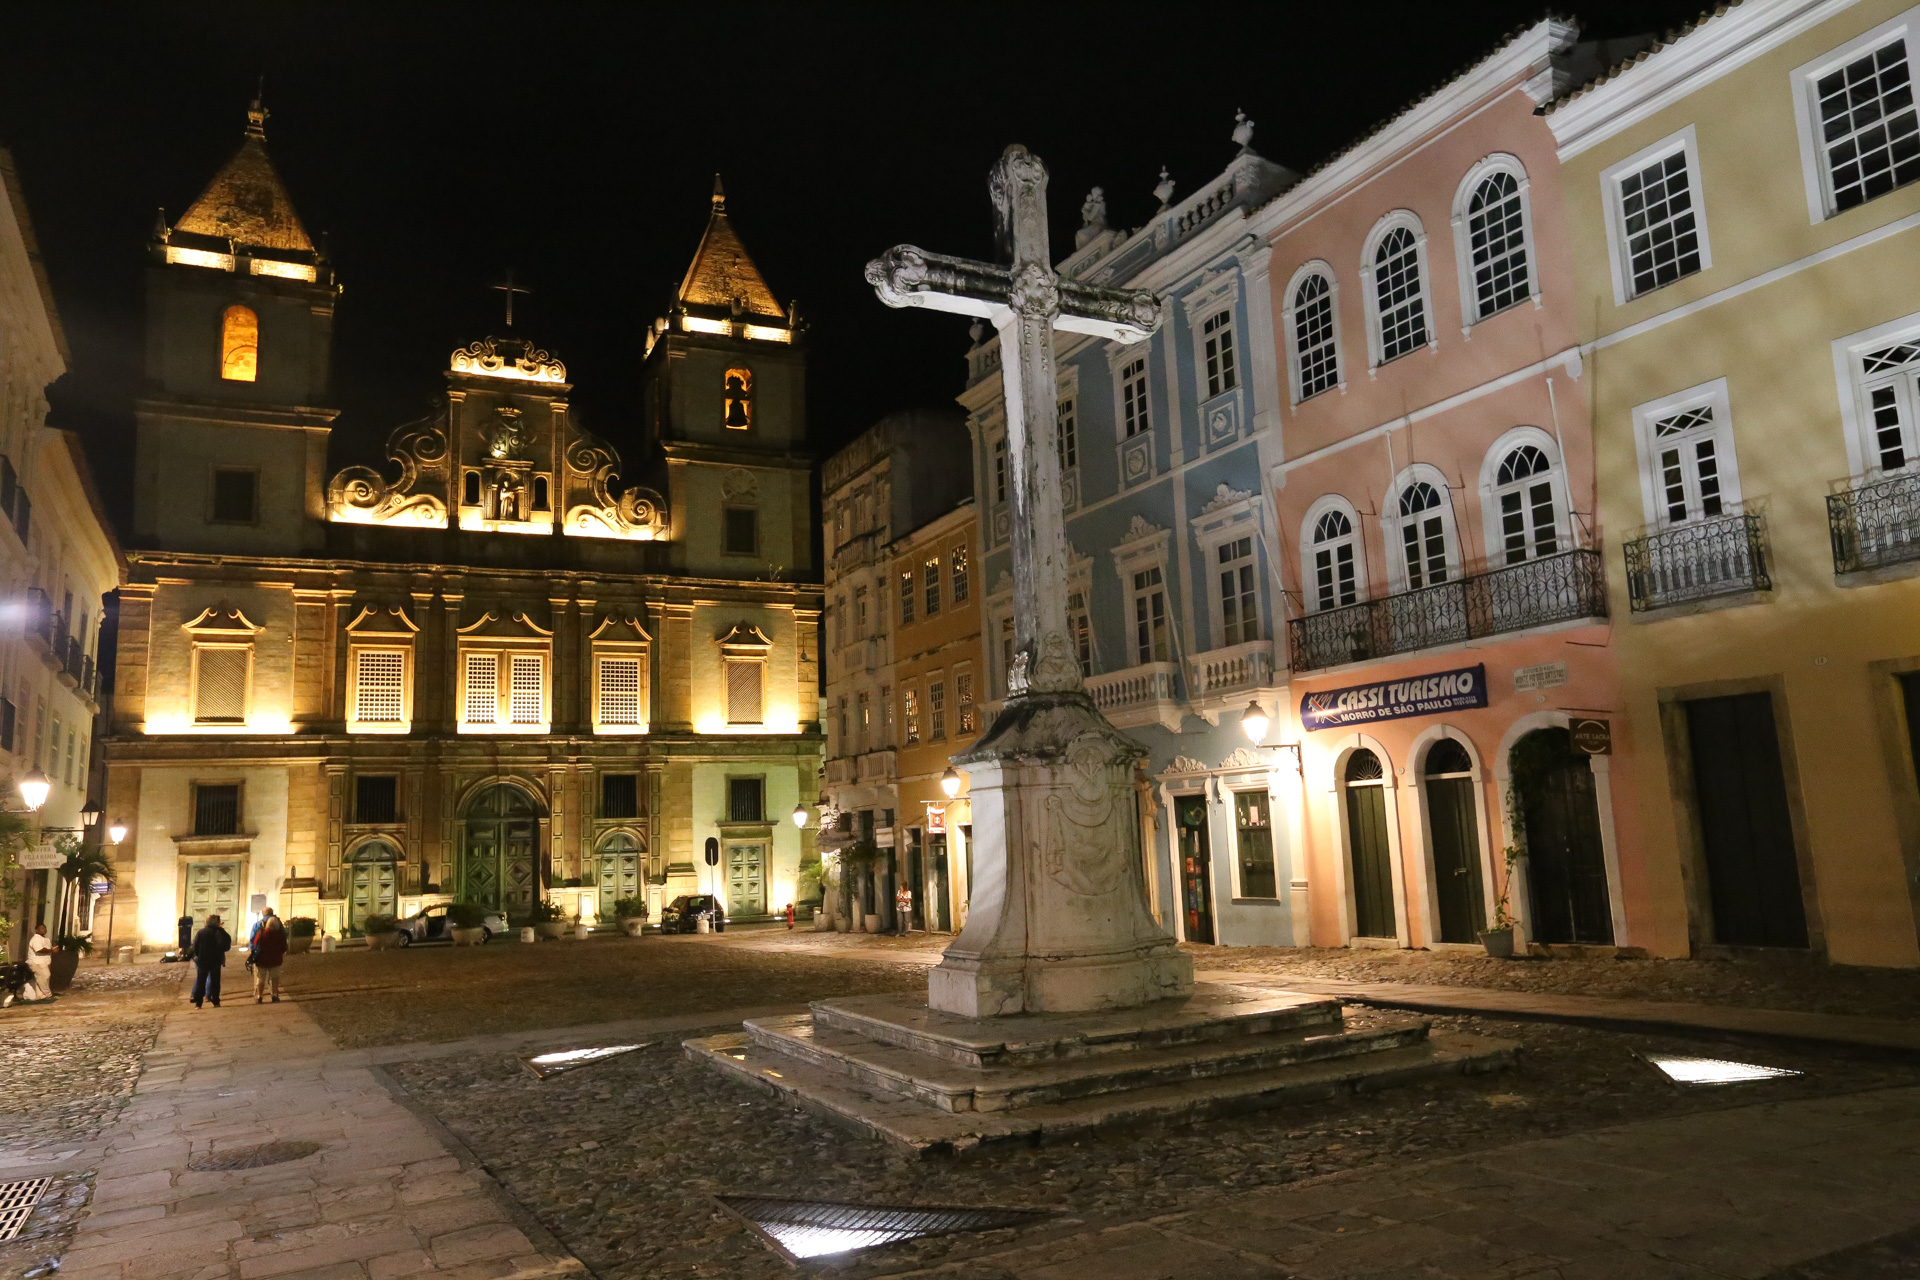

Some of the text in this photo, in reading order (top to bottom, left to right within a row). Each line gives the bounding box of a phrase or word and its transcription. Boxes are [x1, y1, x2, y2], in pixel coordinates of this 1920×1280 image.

[1337, 672, 1474, 711] CASSI TURISMO
[1340, 710, 1376, 722] MORRO
[1379, 708, 1392, 717] DE
[1394, 703, 1415, 715] SÃO
[1418, 699, 1452, 711] PAULO
